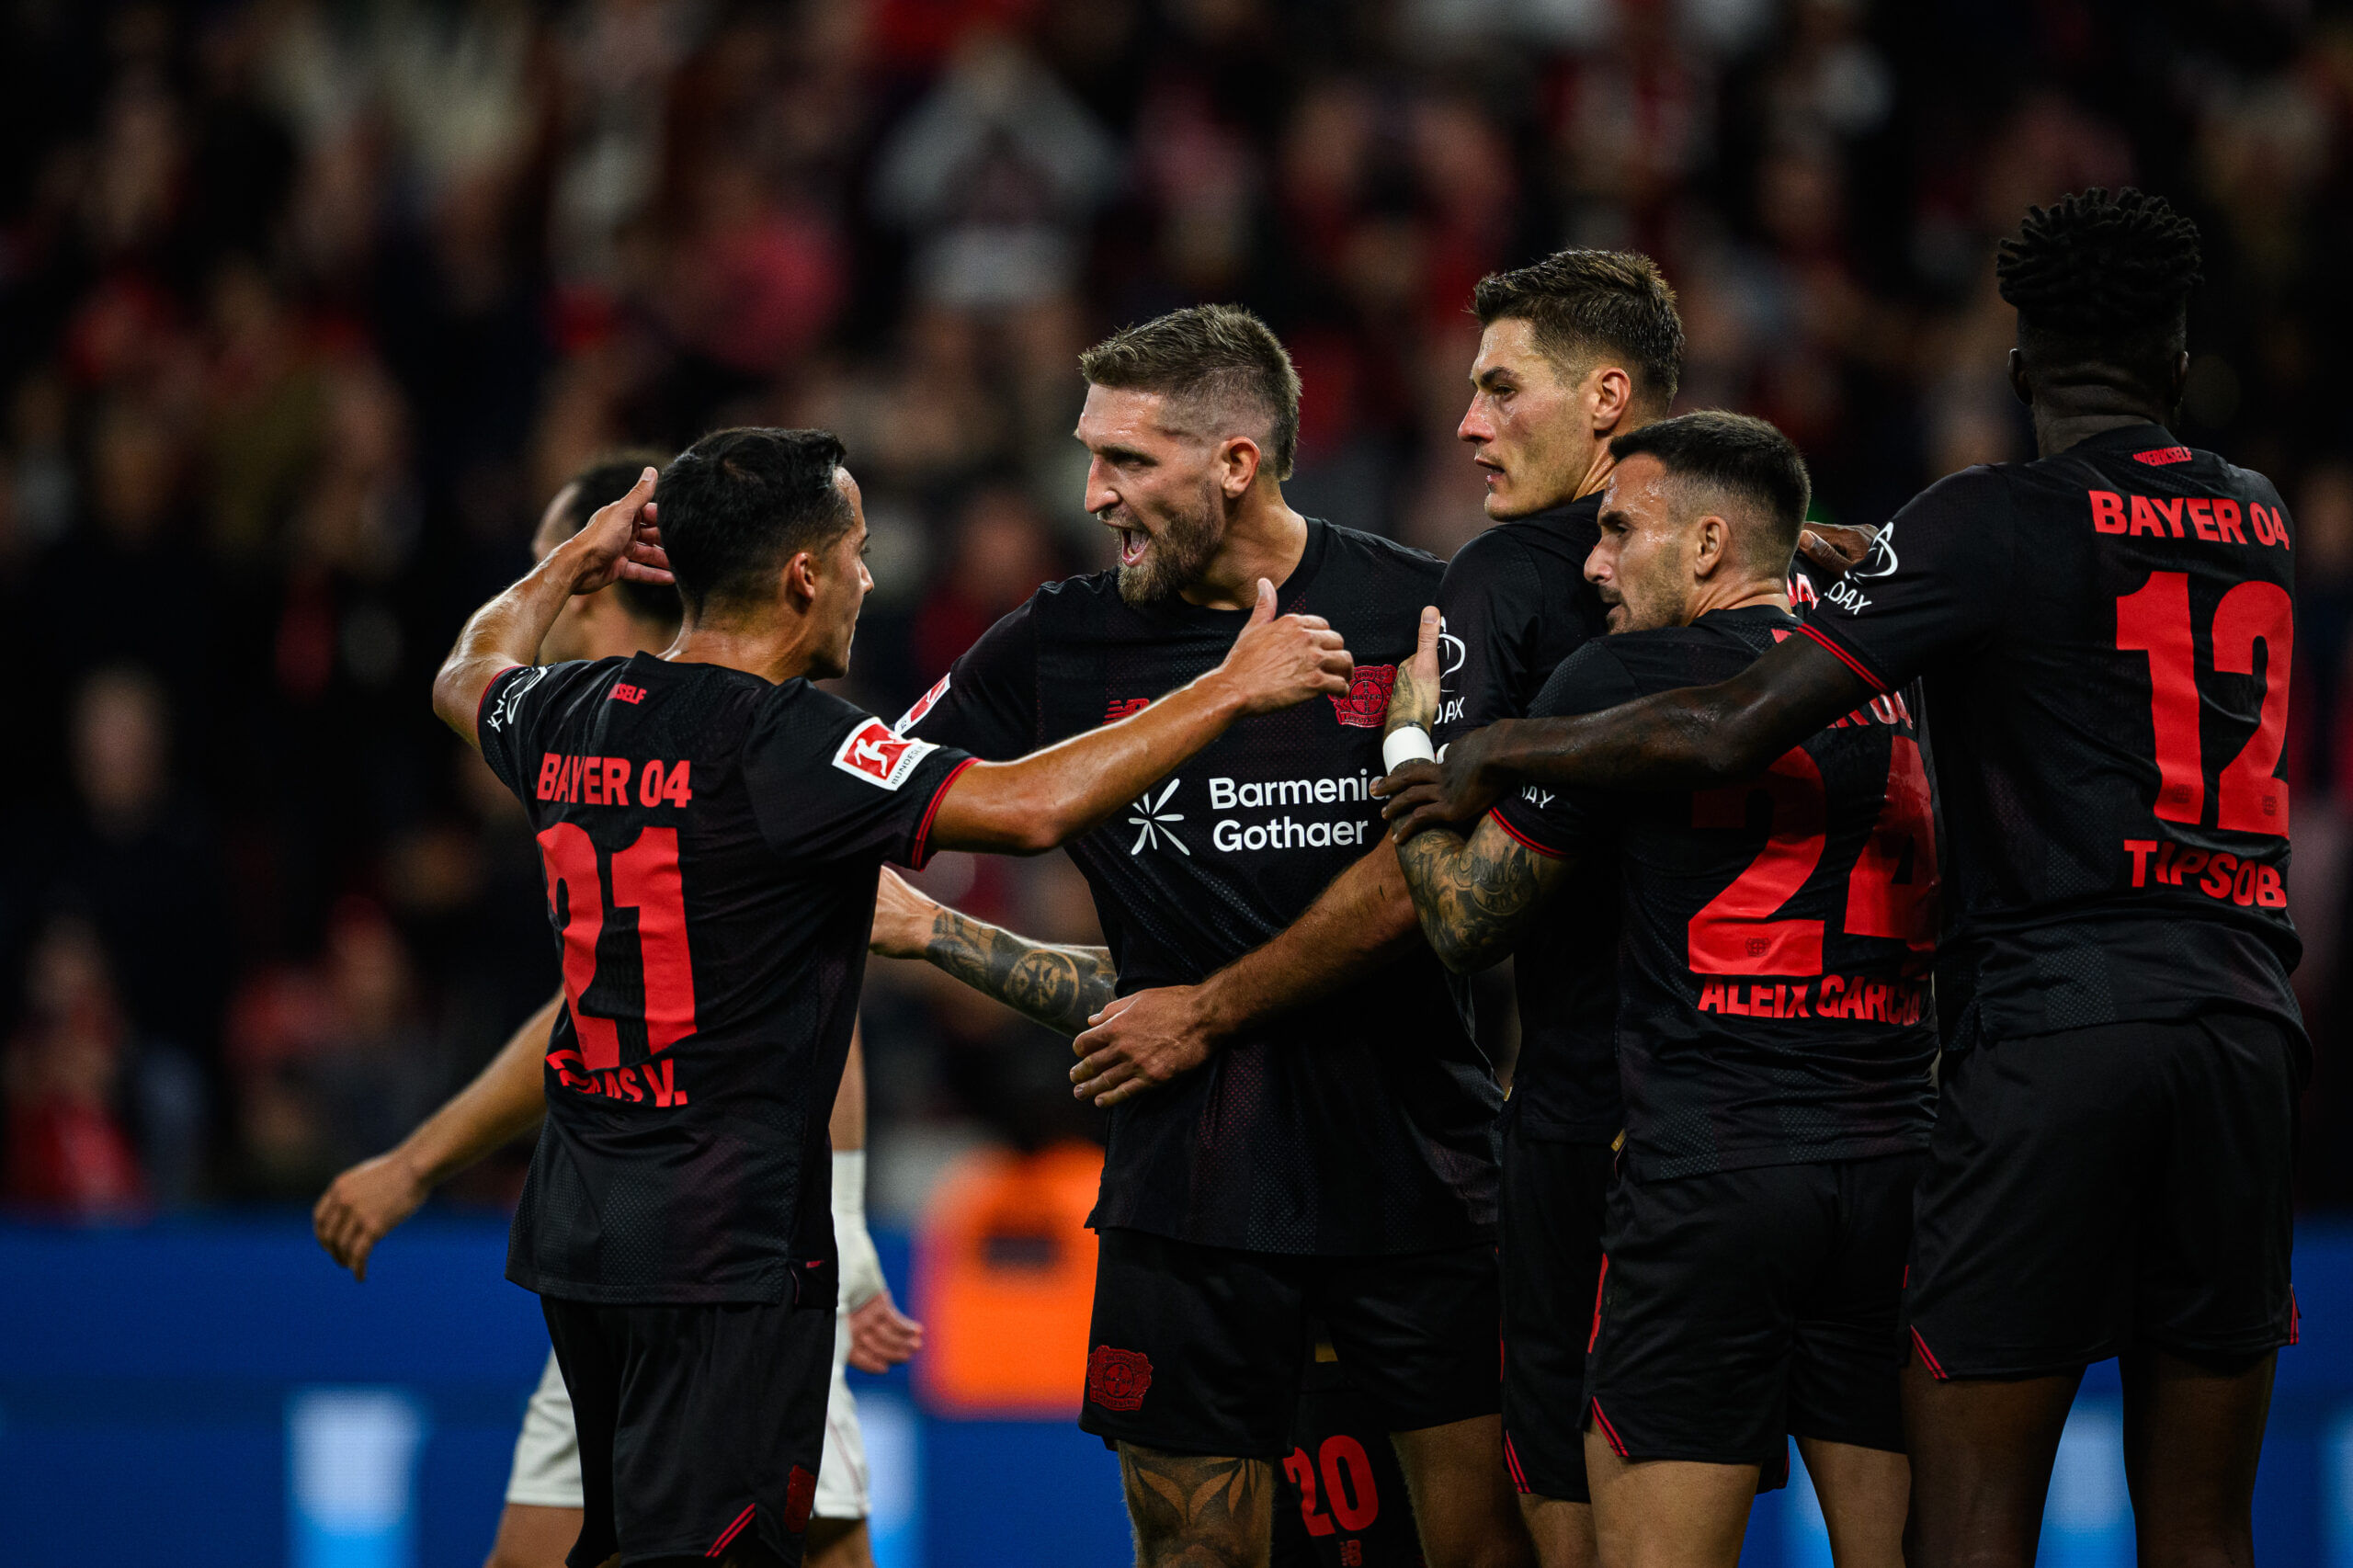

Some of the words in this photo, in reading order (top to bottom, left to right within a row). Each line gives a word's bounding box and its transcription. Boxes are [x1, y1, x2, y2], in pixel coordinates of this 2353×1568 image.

[2088, 490, 2248, 545] BAYER
[2249, 501, 2290, 551] 04
[2115, 570, 2294, 840] 12
[536, 753, 630, 807] BAYER
[639, 759, 693, 809] 04
[1212, 816, 1369, 853] Gothaer
[1688, 735, 1938, 976] 24
[536, 822, 698, 1071] 21
[1698, 974, 1813, 1019] ALEIX
[641, 1058, 689, 1108] V.
[1281, 1434, 1380, 1538] 20
